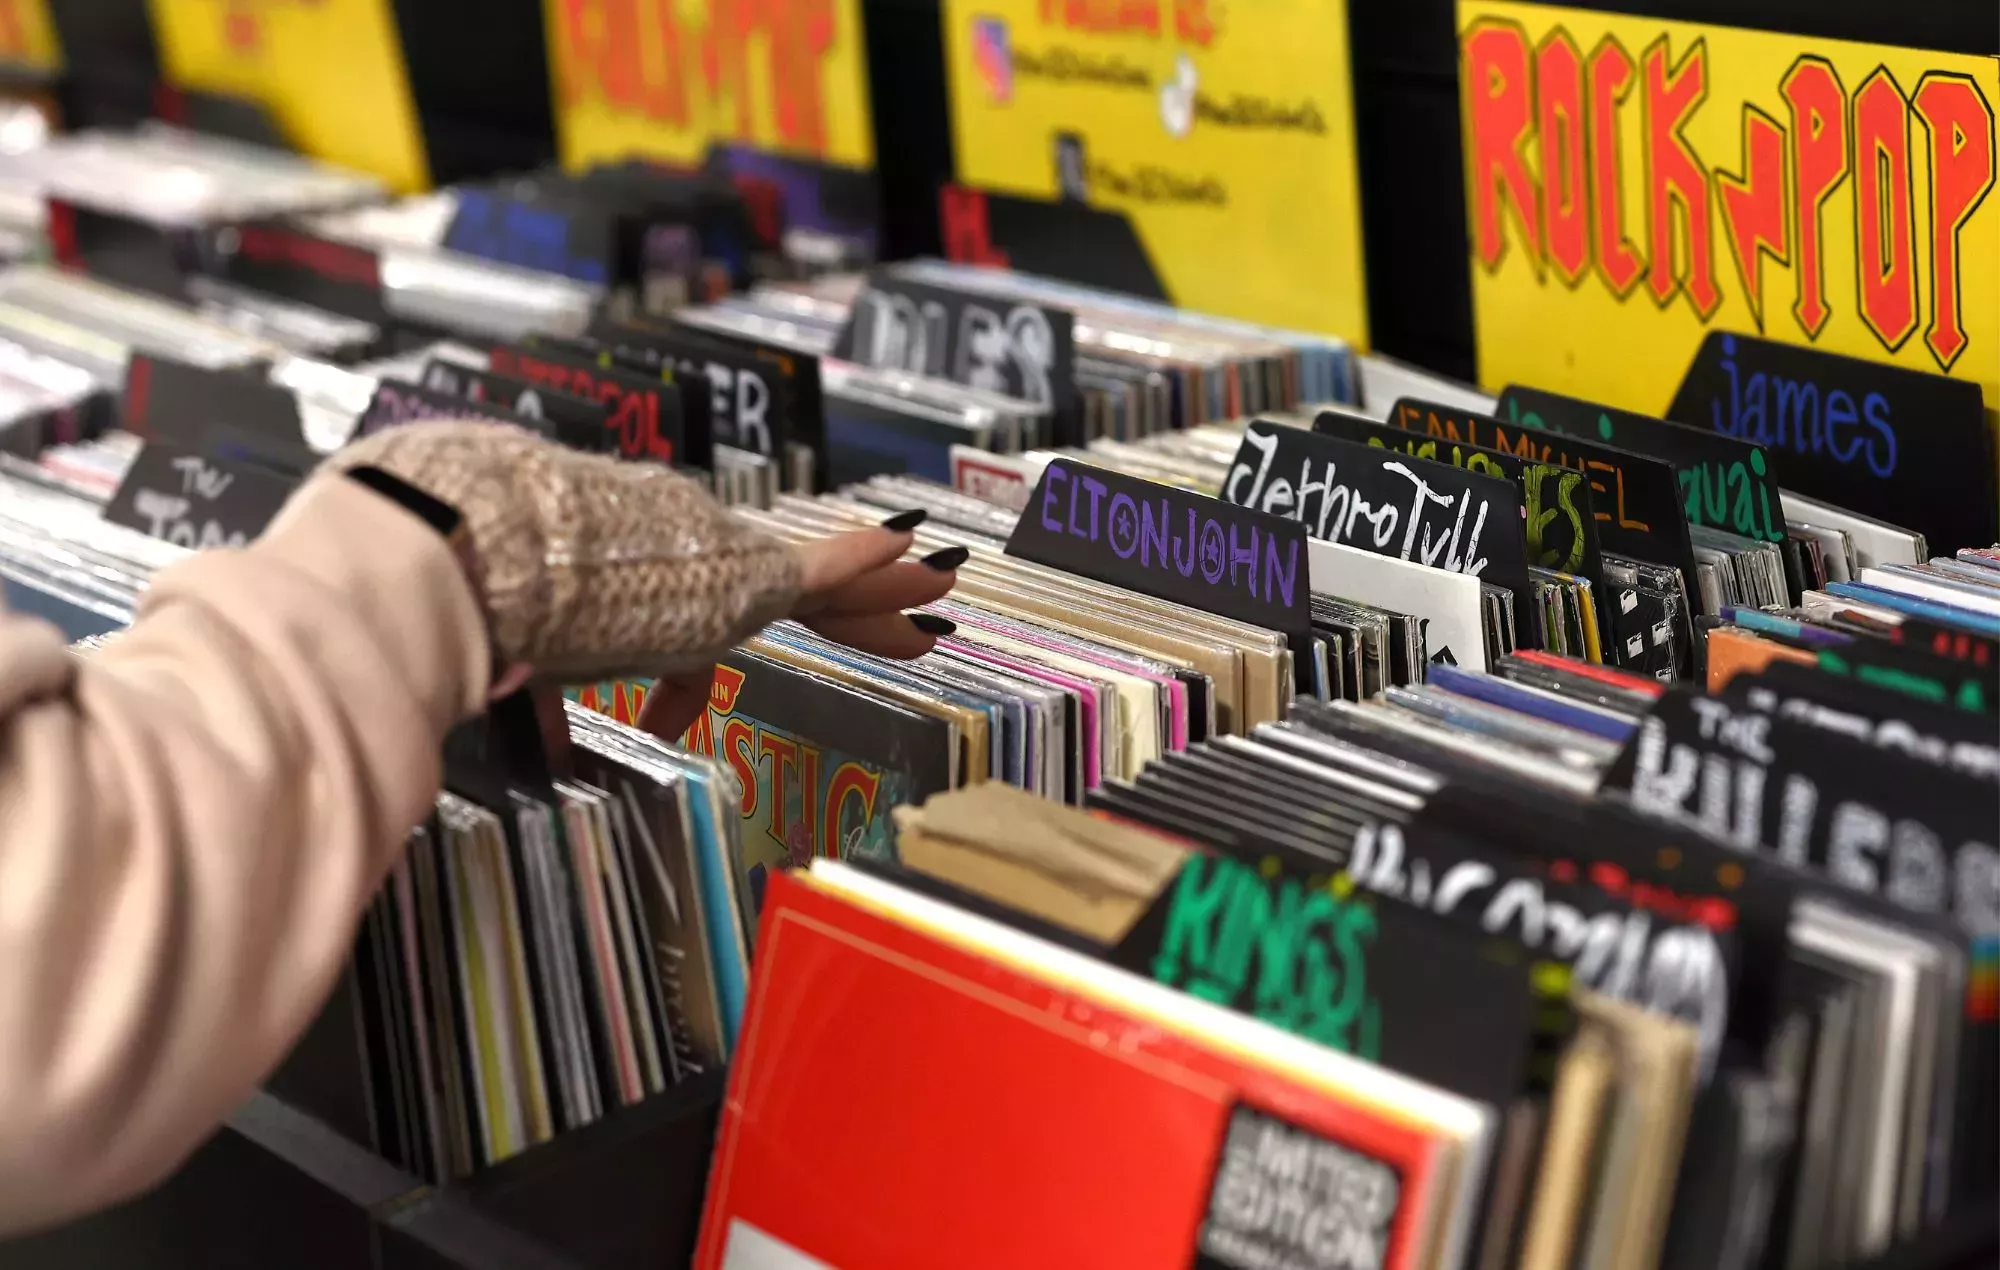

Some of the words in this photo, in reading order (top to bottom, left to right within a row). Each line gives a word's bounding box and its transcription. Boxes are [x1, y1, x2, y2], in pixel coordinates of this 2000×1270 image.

[1457, 17, 1725, 324] ROCK
[1778, 53, 1997, 374] POP
[1711, 330, 1897, 479] james
[1382, 460, 1489, 577] Tull
[1152, 850, 1378, 1042] KINGS
